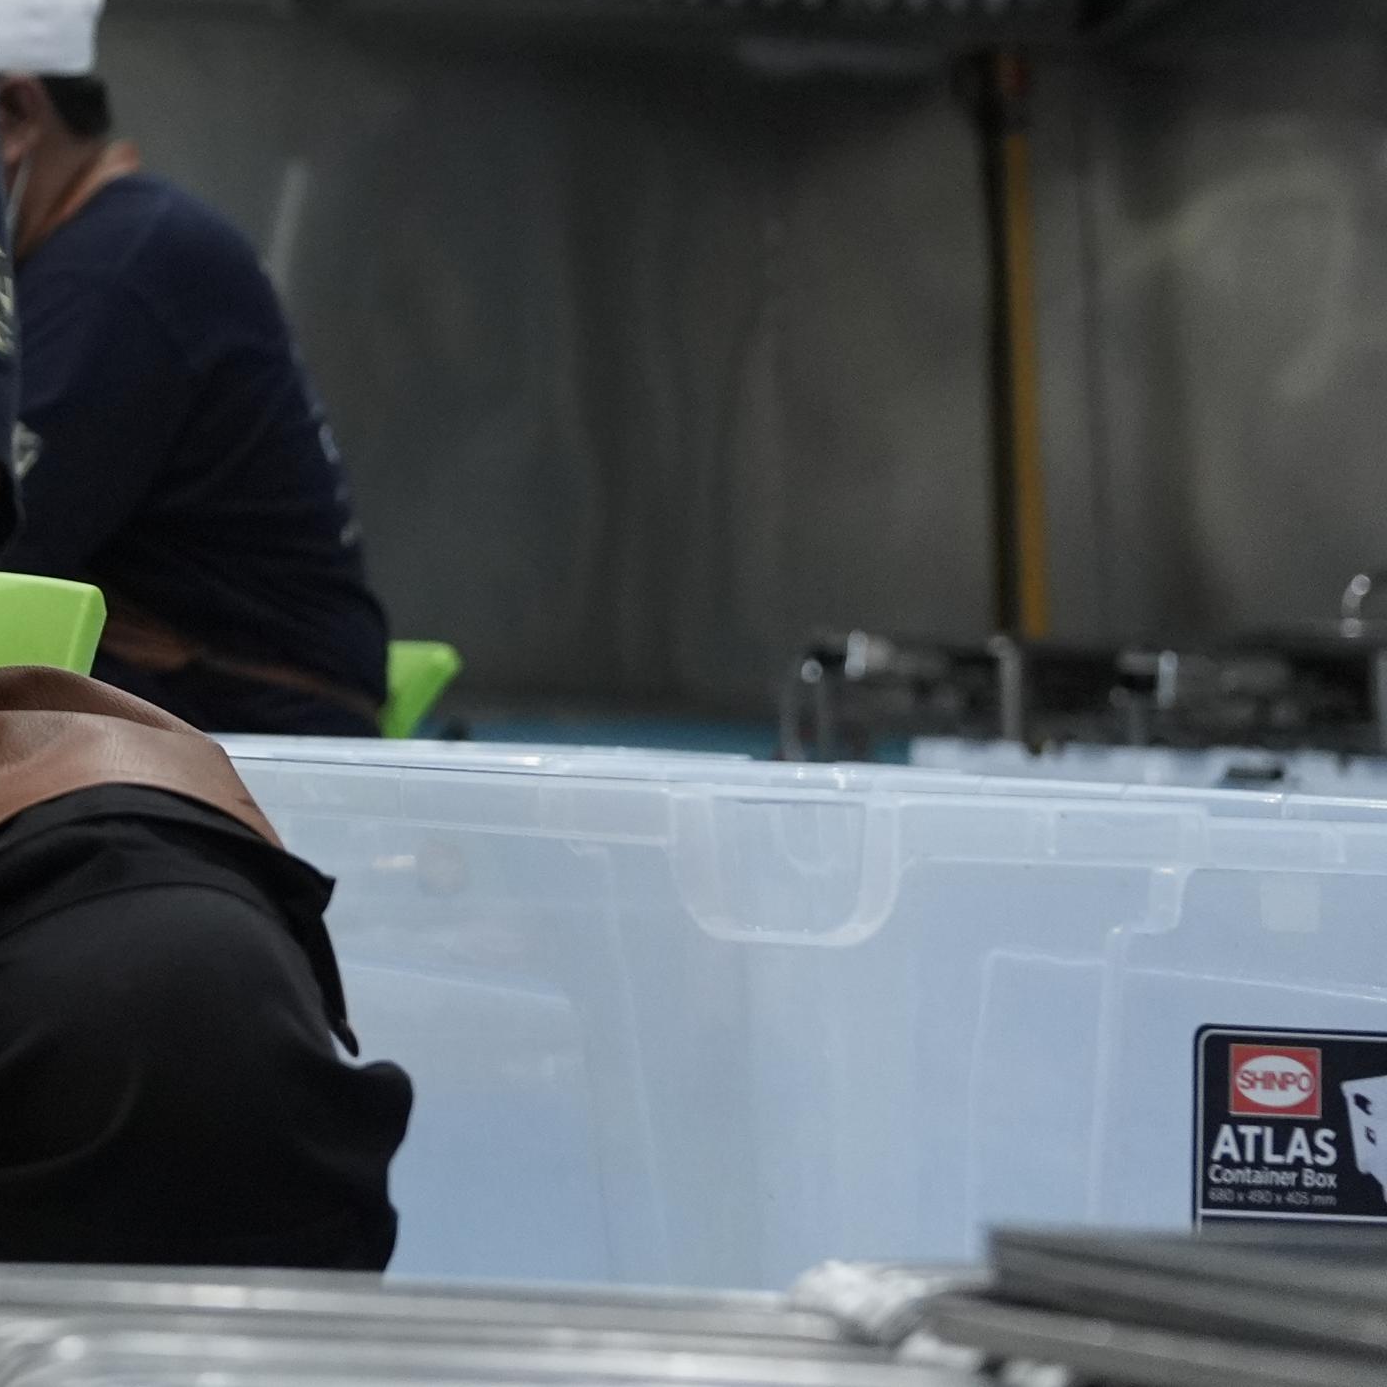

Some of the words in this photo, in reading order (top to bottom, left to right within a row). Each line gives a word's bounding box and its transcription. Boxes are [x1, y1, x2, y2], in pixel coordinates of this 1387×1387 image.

[1238, 1070, 1311, 1092] SHINPO
[1211, 1124, 1337, 1166] ATLAS
[1209, 1164, 1297, 1186] Container
[1302, 1167, 1337, 1188] Box
[1311, 1195, 1337, 1207] mm
